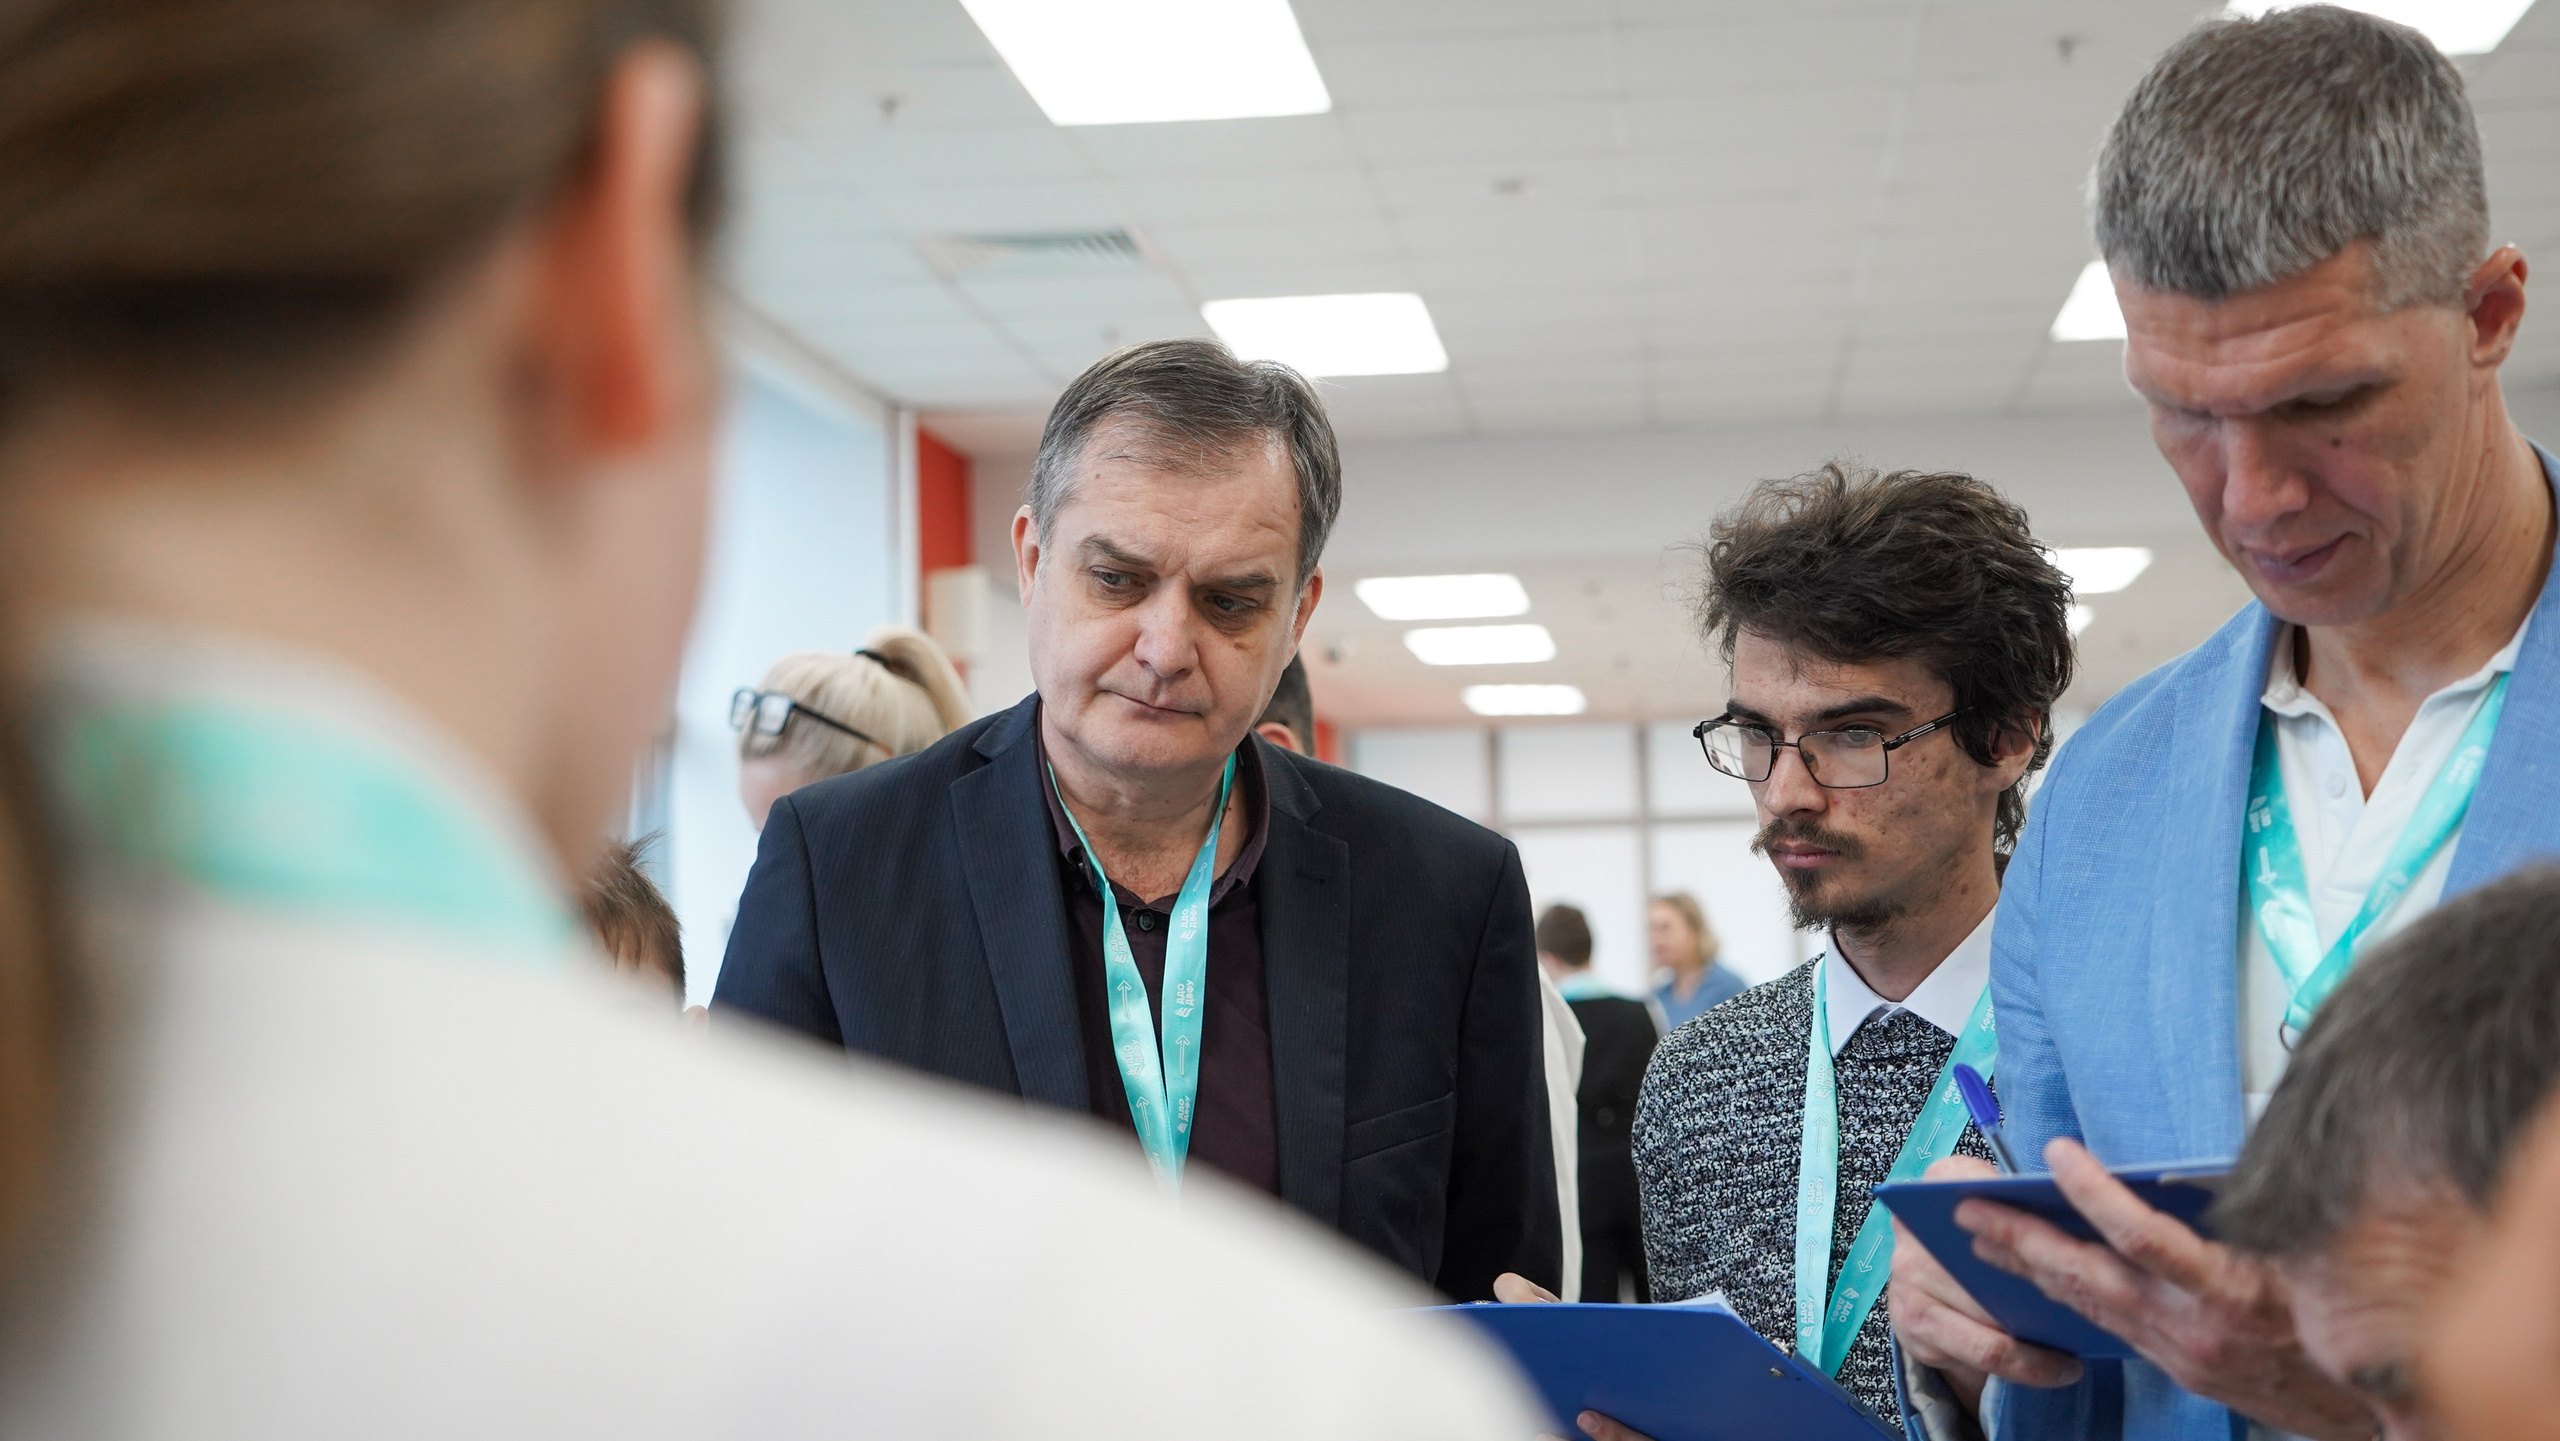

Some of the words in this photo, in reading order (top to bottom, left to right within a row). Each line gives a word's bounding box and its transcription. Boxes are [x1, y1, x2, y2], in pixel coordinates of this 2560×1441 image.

[1181, 909, 1189, 928] ДДО
[1190, 904, 1198, 928] ДВФУ
[1176, 983, 1185, 1005] ДДО
[1185, 979, 1194, 1006] ДВФУ
[1124, 1044, 1134, 1064] ДДО
[1132, 1039, 1144, 1063] ДВФУ
[1816, 1064, 1826, 1087] ДДО
[1807, 1181, 1815, 1203] ДДО
[1815, 1176, 1824, 1203] ДВФУ
[1800, 1301, 1808, 1323] ДДО
[1807, 1296, 1815, 1323] ДВФУ
[1830, 1296, 1846, 1323] ДВФУ
[1839, 1300, 1853, 1322] ДДО
